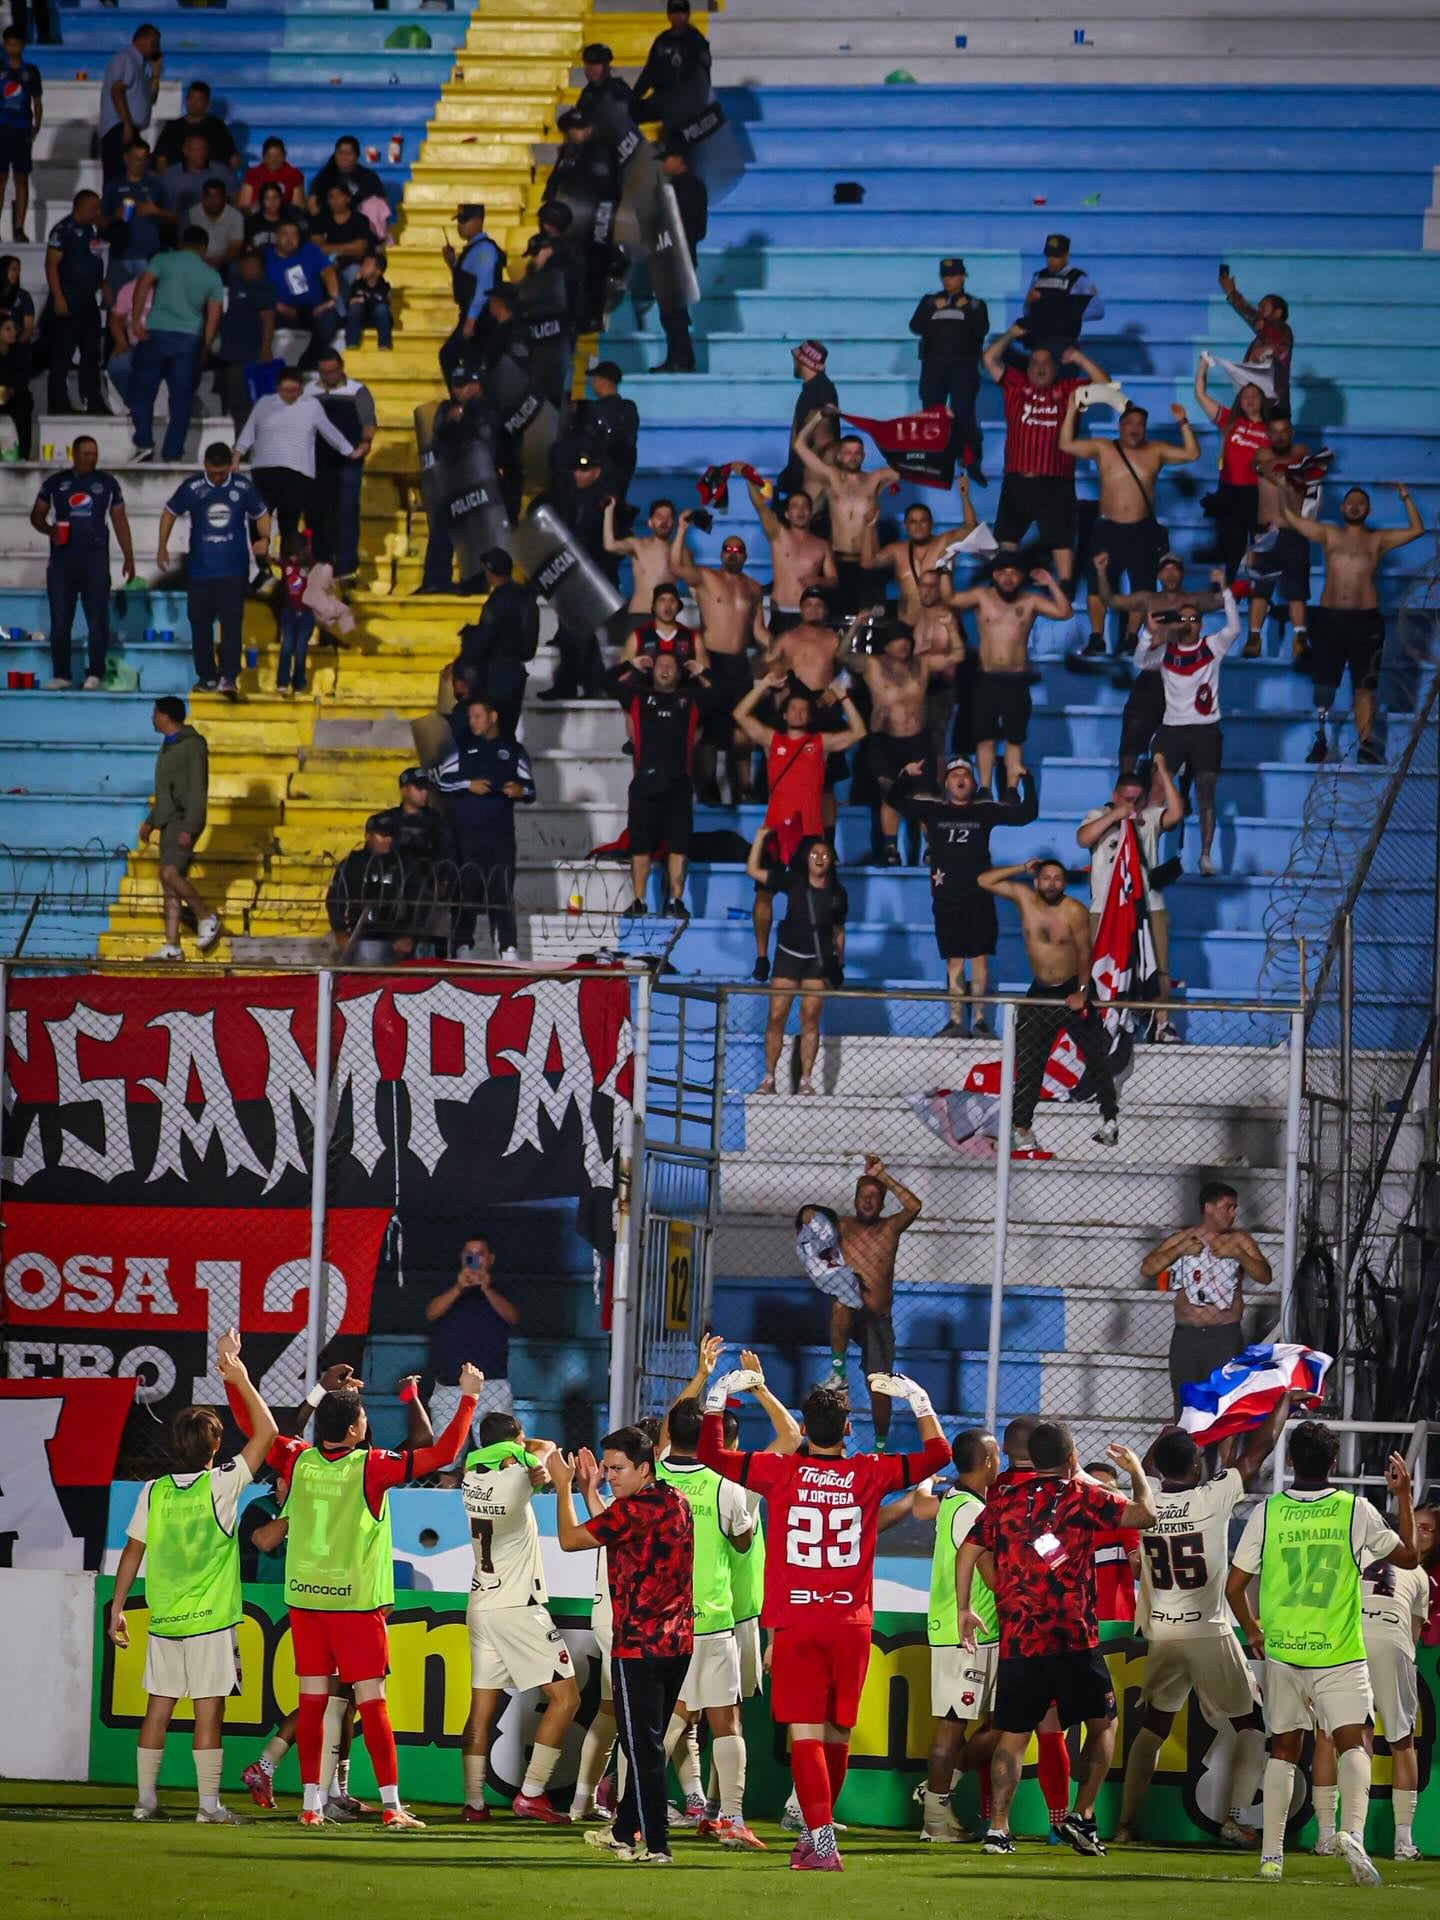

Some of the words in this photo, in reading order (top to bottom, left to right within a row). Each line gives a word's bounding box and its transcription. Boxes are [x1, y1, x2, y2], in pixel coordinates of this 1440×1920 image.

[504, 395, 540, 434] POLICIA
[451, 489, 489, 517] POLICIA
[538, 550, 576, 591] POLICIA
[947, 829, 970, 843] 12
[3, 978, 634, 1195] SAMPA
[191, 1259, 348, 1408] 12
[798, 1466, 855, 1489] Tropical
[797, 1489, 854, 1505] W.ORTEGA
[1279, 1501, 1340, 1523] Tropical
[786, 1505, 862, 1568] 23
[1147, 1522, 1195, 1534] PARKINS
[1278, 1527, 1345, 1545] F.SAMADIAN
[470, 1517, 495, 1574] 7
[1143, 1532, 1208, 1591] 35
[289, 1579, 353, 1597] Concacaf
[790, 1590, 853, 1604] BYD
[1361, 1607, 1400, 1625] YD
[1268, 1637, 1332, 1651] oncacaf.com
